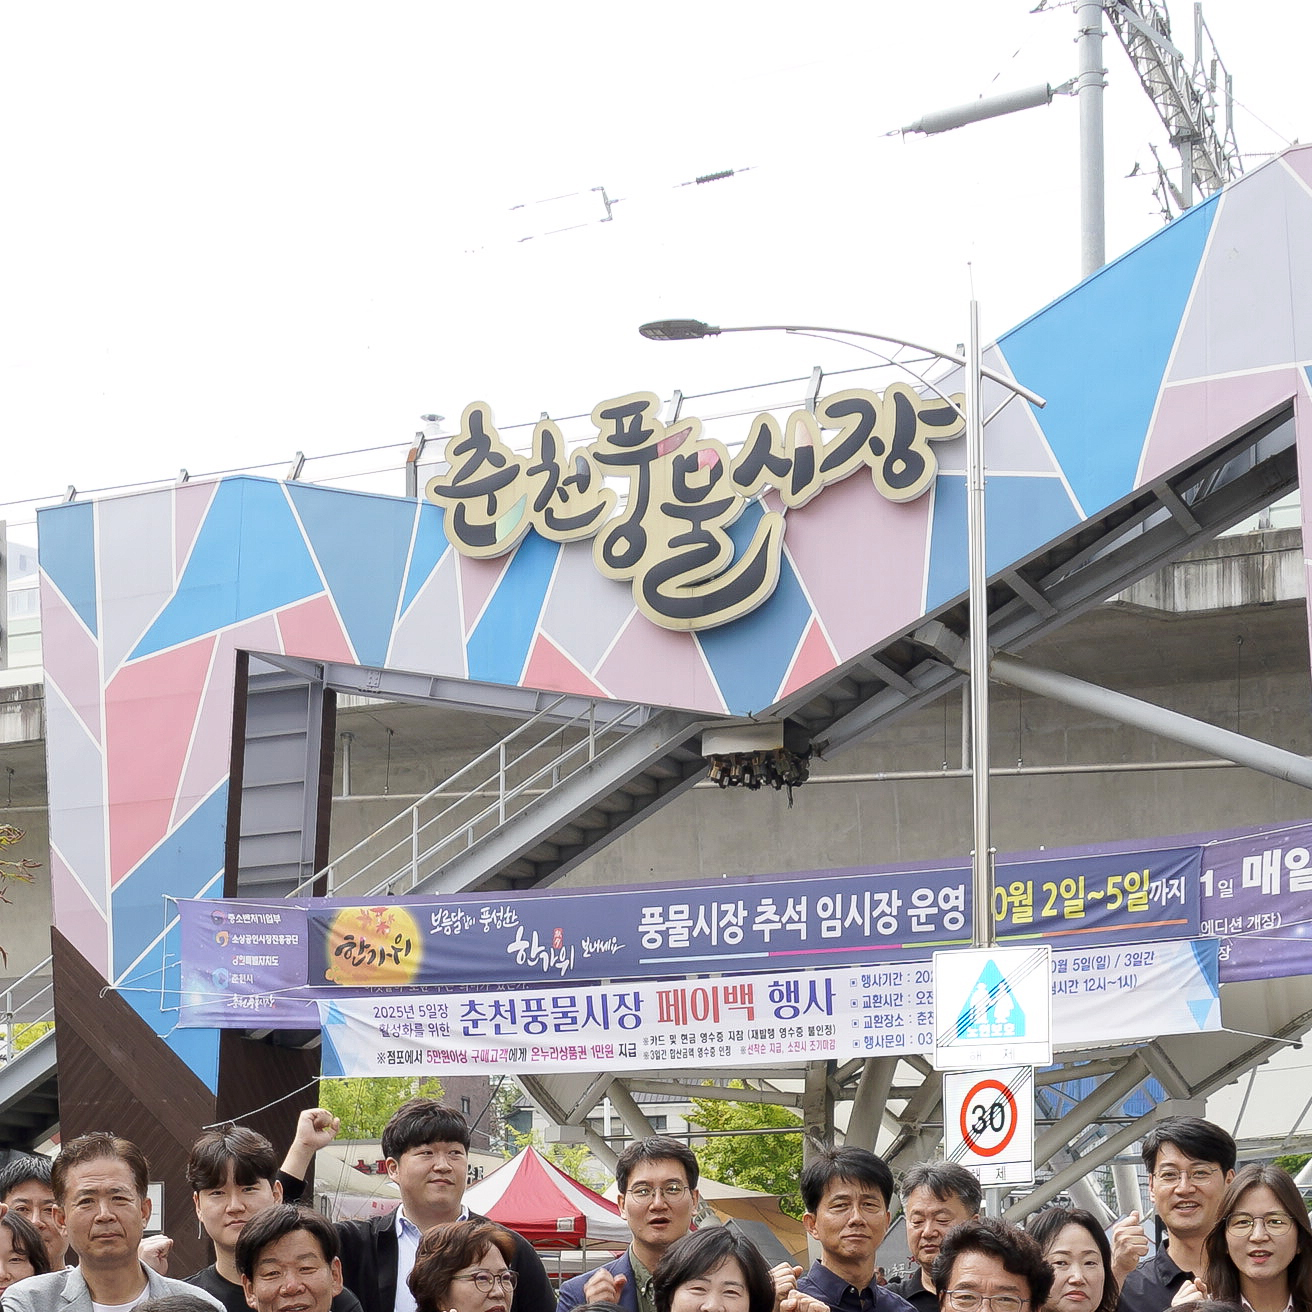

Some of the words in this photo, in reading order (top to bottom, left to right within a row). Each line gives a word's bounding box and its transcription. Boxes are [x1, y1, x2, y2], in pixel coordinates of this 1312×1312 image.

[428, 386, 965, 626] 춘천풍물시장
[228, 913, 282, 924] 중소벤처기업부
[479, 905, 520, 933] 풍성한
[638, 900, 748, 951] 풍물시장
[752, 895, 809, 943] 추석
[816, 888, 903, 939] 임시장
[906, 882, 967, 934] 운영
[993, 883, 1034, 924] 0월
[1200, 917, 1243, 937] 에디션
[1246, 911, 1282, 931] 개장)
[231, 934, 299, 945] 소상공인시장진흥공단
[334, 933, 412, 968] 한가위
[507, 925, 575, 977] 한가위
[581, 935, 627, 958] 보내세요
[861, 971, 904, 989] 행사기간
[1073, 953, 1111, 972] 5일(일)
[1124, 950, 1155, 967] 3일간
[862, 991, 904, 1009] 교환시간
[1084, 974, 1138, 993] 12시~1시)
[373, 1004, 415, 1020] 2025년
[418, 1003, 449, 1019] 5일장
[459, 990, 644, 1038] 춘천풍물시장
[655, 982, 756, 1027] 페이백
[768, 977, 837, 1021] 행사
[863, 1012, 905, 1029] 교환장소
[378, 1022, 425, 1039] 활성화를
[428, 1021, 451, 1038] 위한
[680, 1033, 696, 1045] 현금
[728, 1029, 744, 1042] 지참
[864, 1033, 906, 1050] 행사문의
[426, 1046, 468, 1065] 5만원이상
[471, 1046, 527, 1064] 구매고객에게
[530, 1043, 587, 1063] 온누리상품권
[590, 1042, 614, 1060] 1만원
[618, 1041, 638, 1059] 지급
[971, 1101, 1006, 1134] 30
